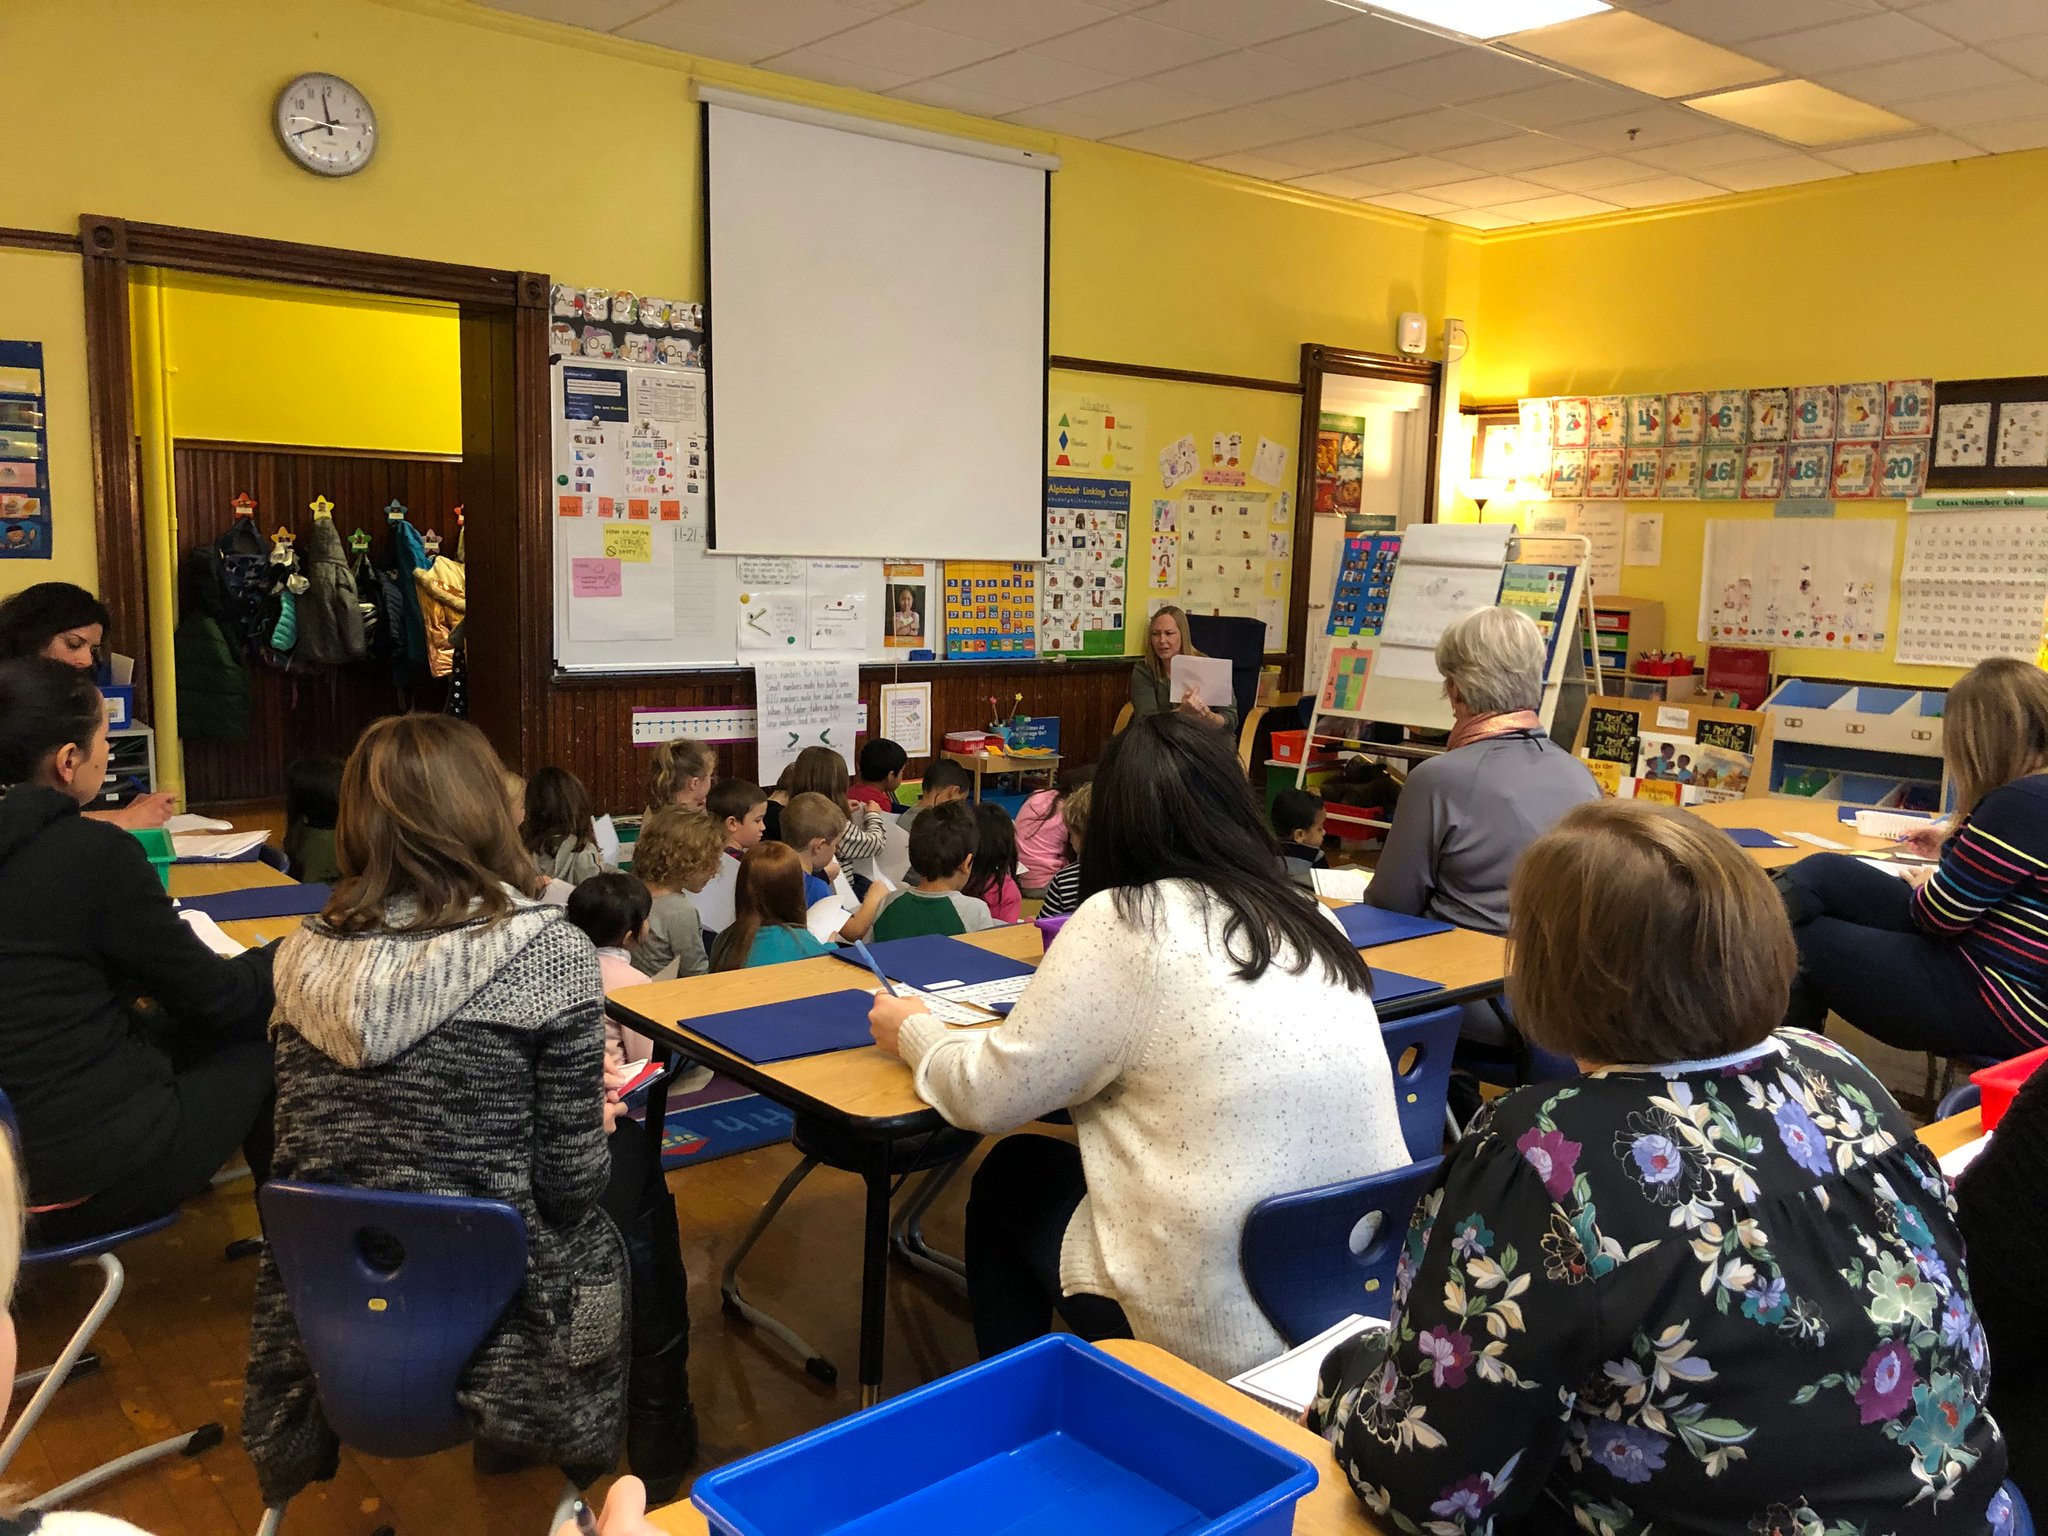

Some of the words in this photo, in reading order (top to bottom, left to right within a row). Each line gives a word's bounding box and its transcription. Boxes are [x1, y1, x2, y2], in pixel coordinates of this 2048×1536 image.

[558, 294, 573, 307] Aa
[679, 309, 692, 321] Ee
[553, 333, 570, 345] Nn
[589, 338, 605, 350] Oo
[630, 341, 643, 358] Pp
[666, 345, 685, 362] Qq
[1802, 400, 1817, 423] 8
[1894, 394, 1919, 417] 10
[1719, 406, 1732, 428] 6
[1632, 464, 1649, 481] 14
[1710, 463, 1730, 481] 16
[1796, 461, 1817, 480] 18
[1888, 457, 1913, 479] 20
[1048, 484, 1079, 495] Alphabet
[1083, 487, 1105, 498] Linking
[1109, 488, 1128, 496] Chart
[631, 506, 644, 515] look
[663, 506, 678, 516] who
[1962, 498, 2000, 506] Number
